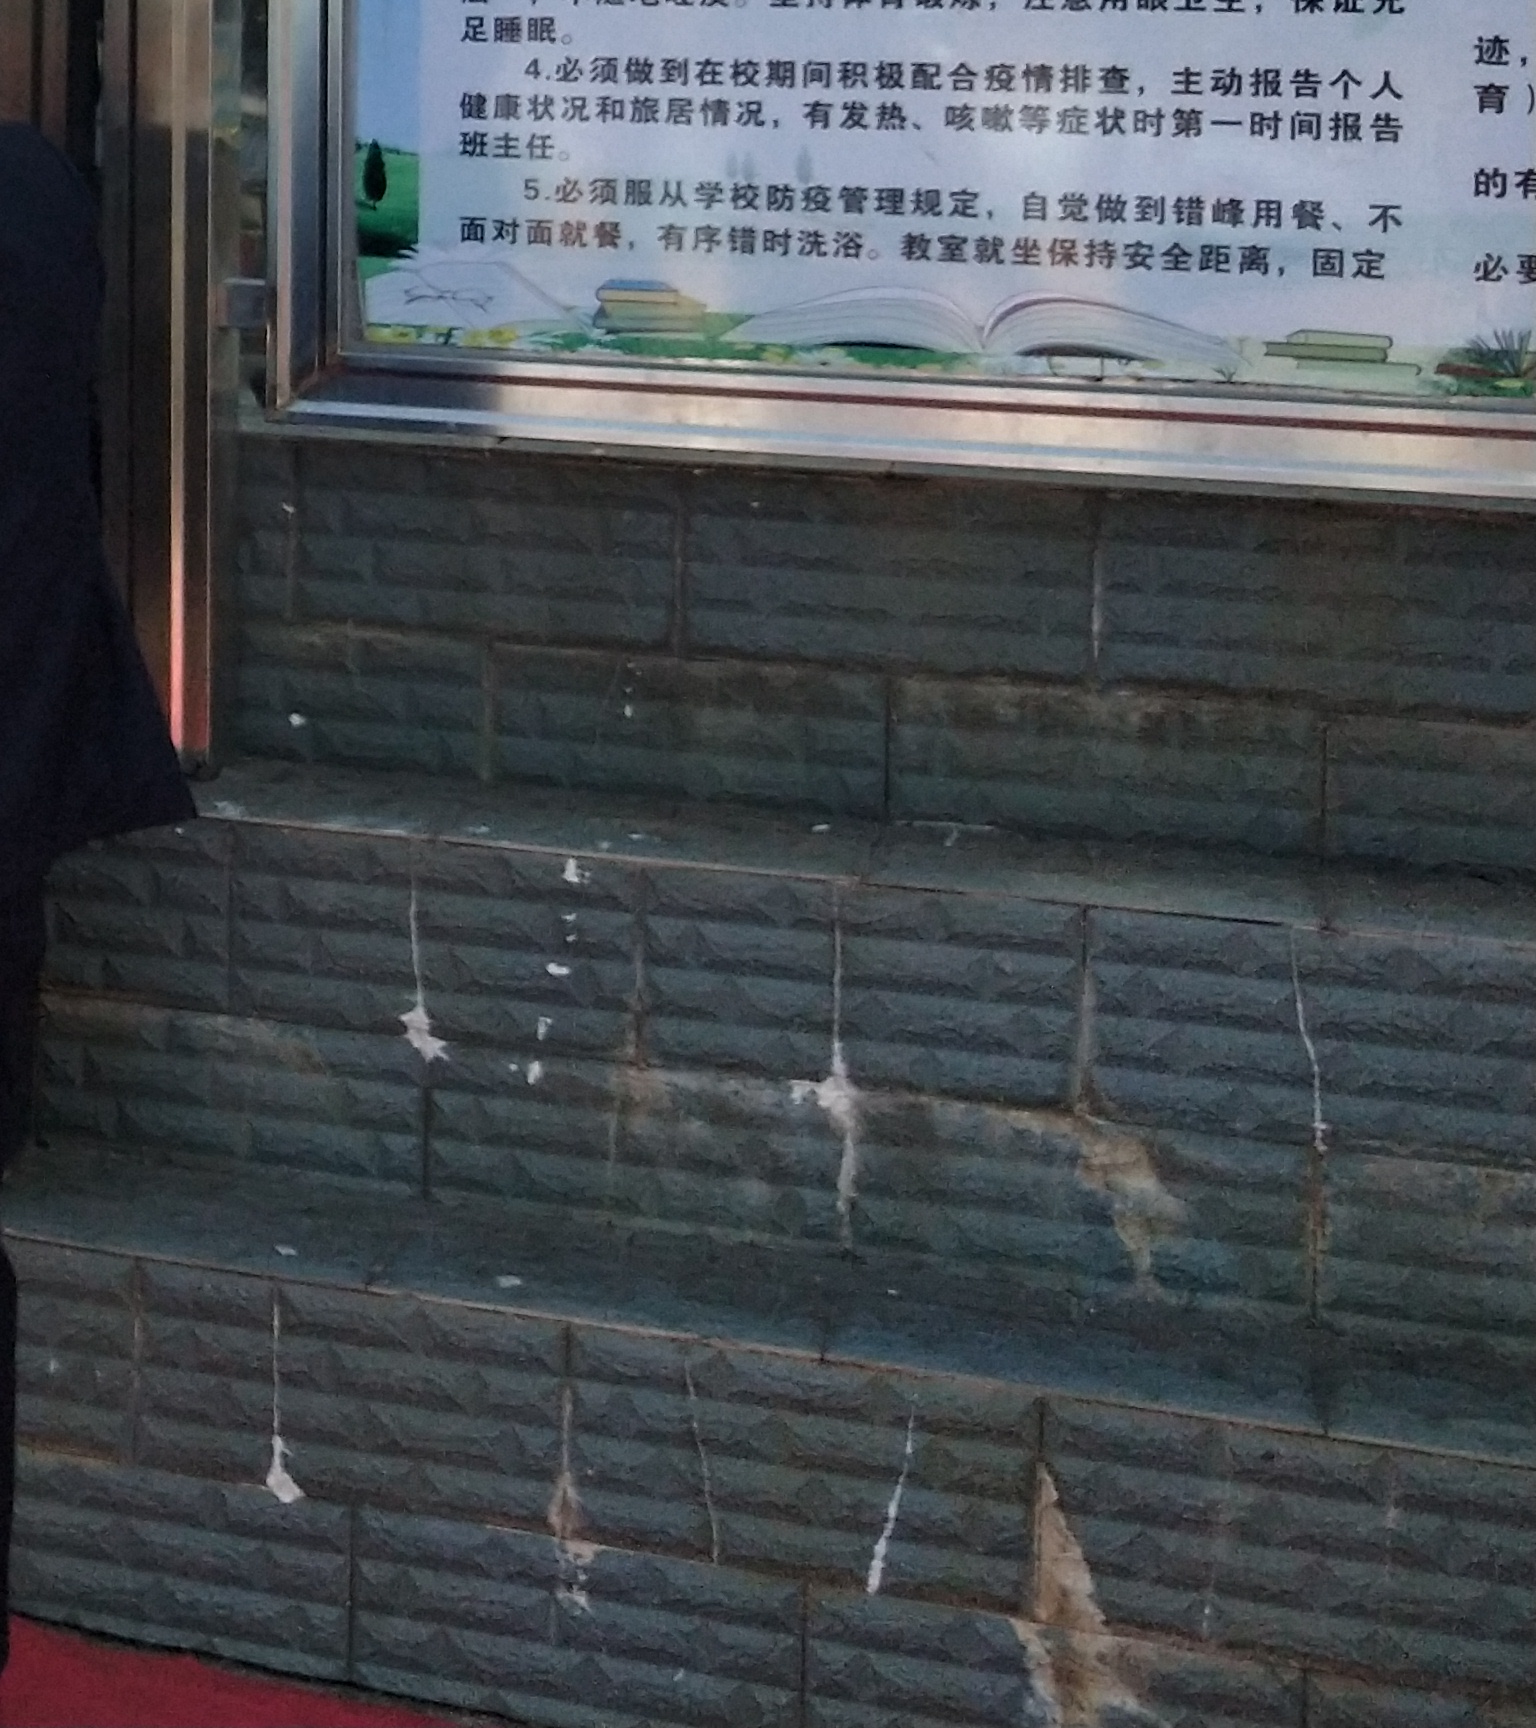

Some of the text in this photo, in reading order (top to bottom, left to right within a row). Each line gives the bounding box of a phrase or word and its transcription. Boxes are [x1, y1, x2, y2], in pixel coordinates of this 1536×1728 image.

[460, 15, 573, 45] 足睡眠。
[1474, 35, 1527, 66] 迹，
[1474, 83, 1535, 114] 育）
[459, 131, 570, 161] 班主任。
